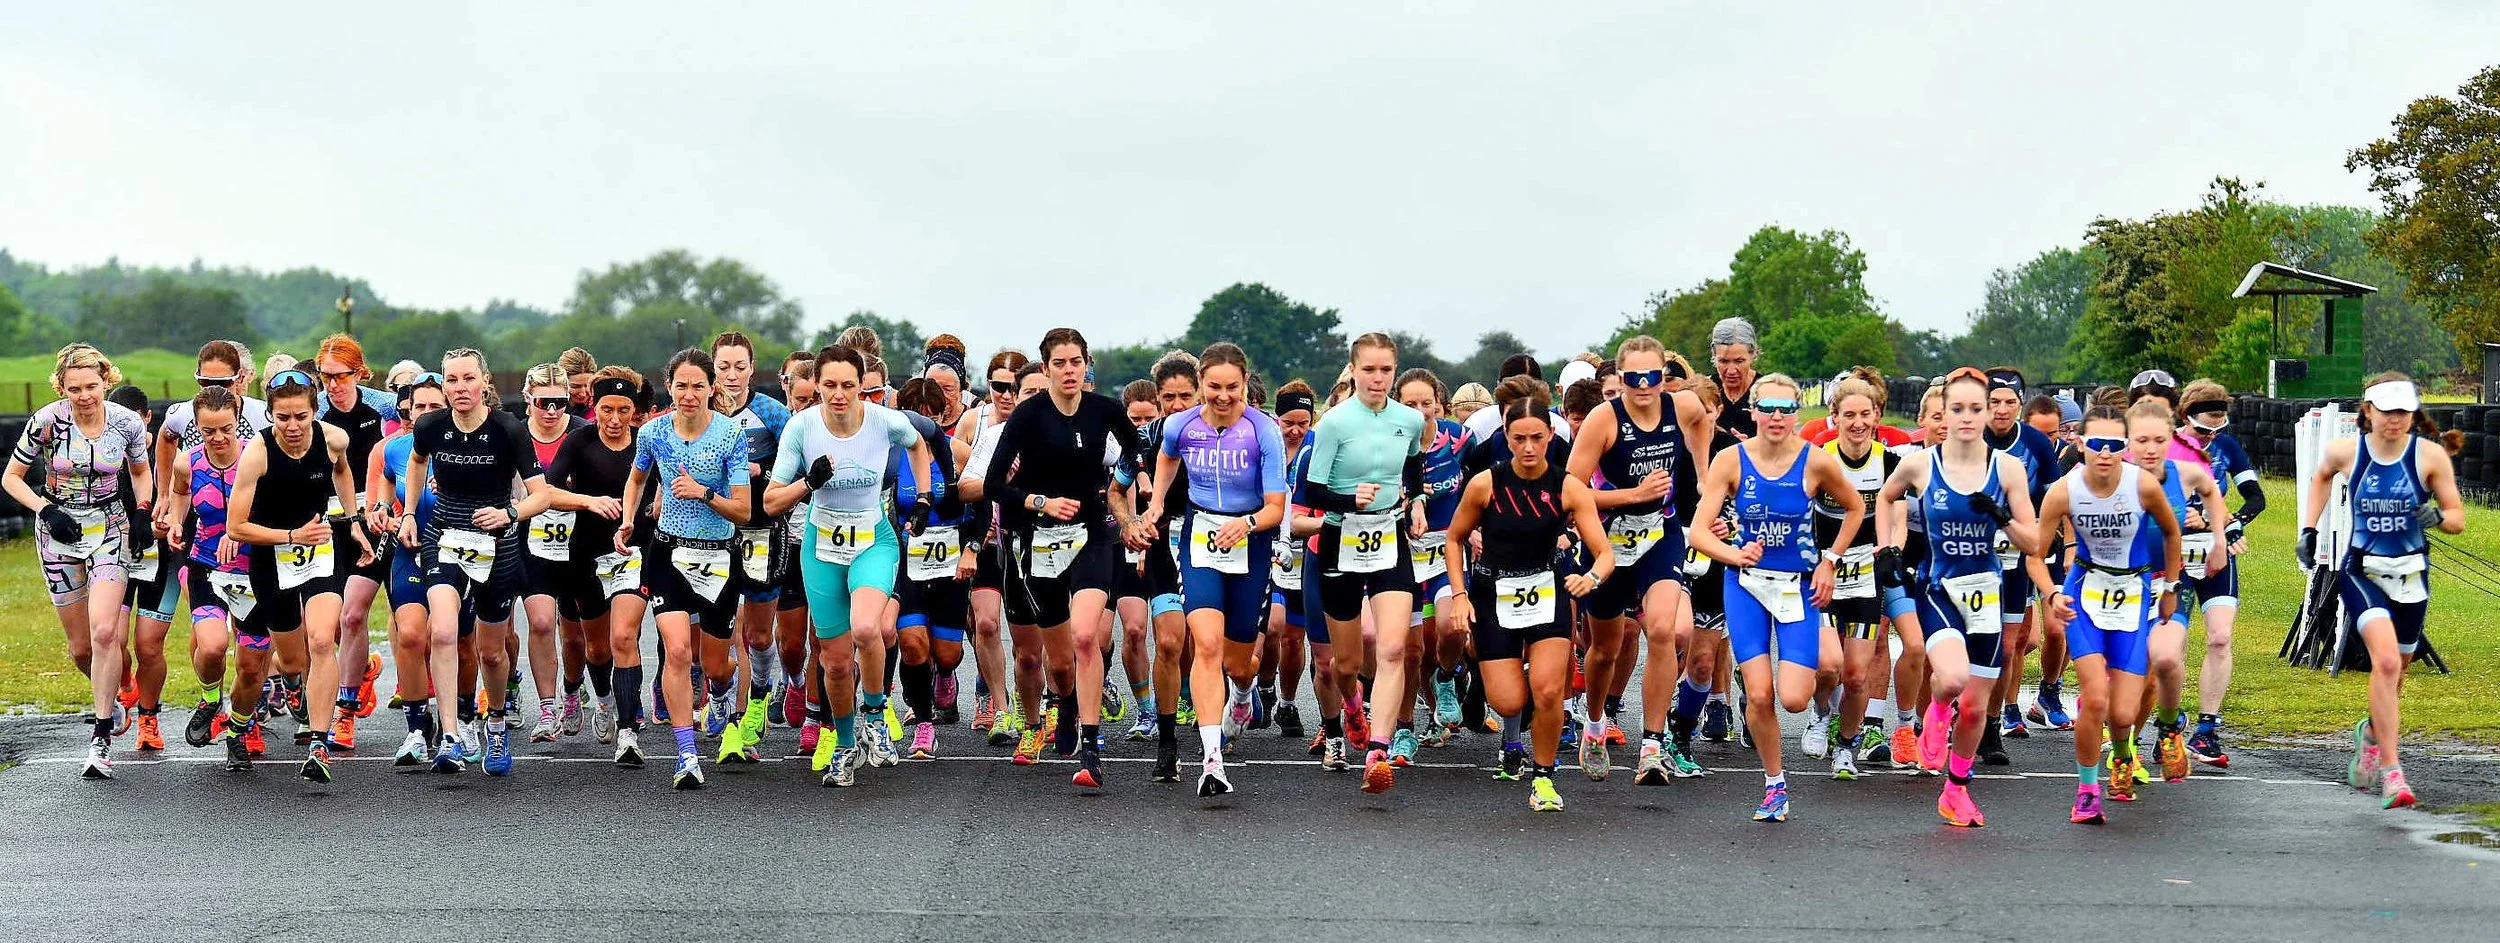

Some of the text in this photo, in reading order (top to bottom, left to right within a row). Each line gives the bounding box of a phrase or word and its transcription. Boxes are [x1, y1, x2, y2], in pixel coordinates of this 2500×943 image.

[1187, 446, 1249, 470] TACTIC
[1628, 456, 1676, 476] DONNELLY
[824, 476, 879, 488] ATENARY
[1432, 473, 1460, 491] SON
[2361, 499, 2411, 514] ENTWISTLE
[1749, 521, 1792, 535] LAMB
[2076, 511, 2132, 528] STEWART
[2366, 516, 2408, 532] GBR
[542, 523, 568, 543] 58
[831, 525, 856, 548] 61
[1941, 521, 1988, 538] SHAW
[2090, 528, 2122, 539] GBR
[676, 538, 719, 550] SUNDRIED
[1355, 530, 1383, 553] 38
[1755, 534, 1786, 547] GBR
[1941, 540, 1989, 556] GBR
[291, 545, 317, 567] 37
[922, 541, 948, 563] 70
[1836, 557, 1861, 583] 44
[1512, 585, 1540, 608] 56
[2101, 588, 2127, 610] 19
